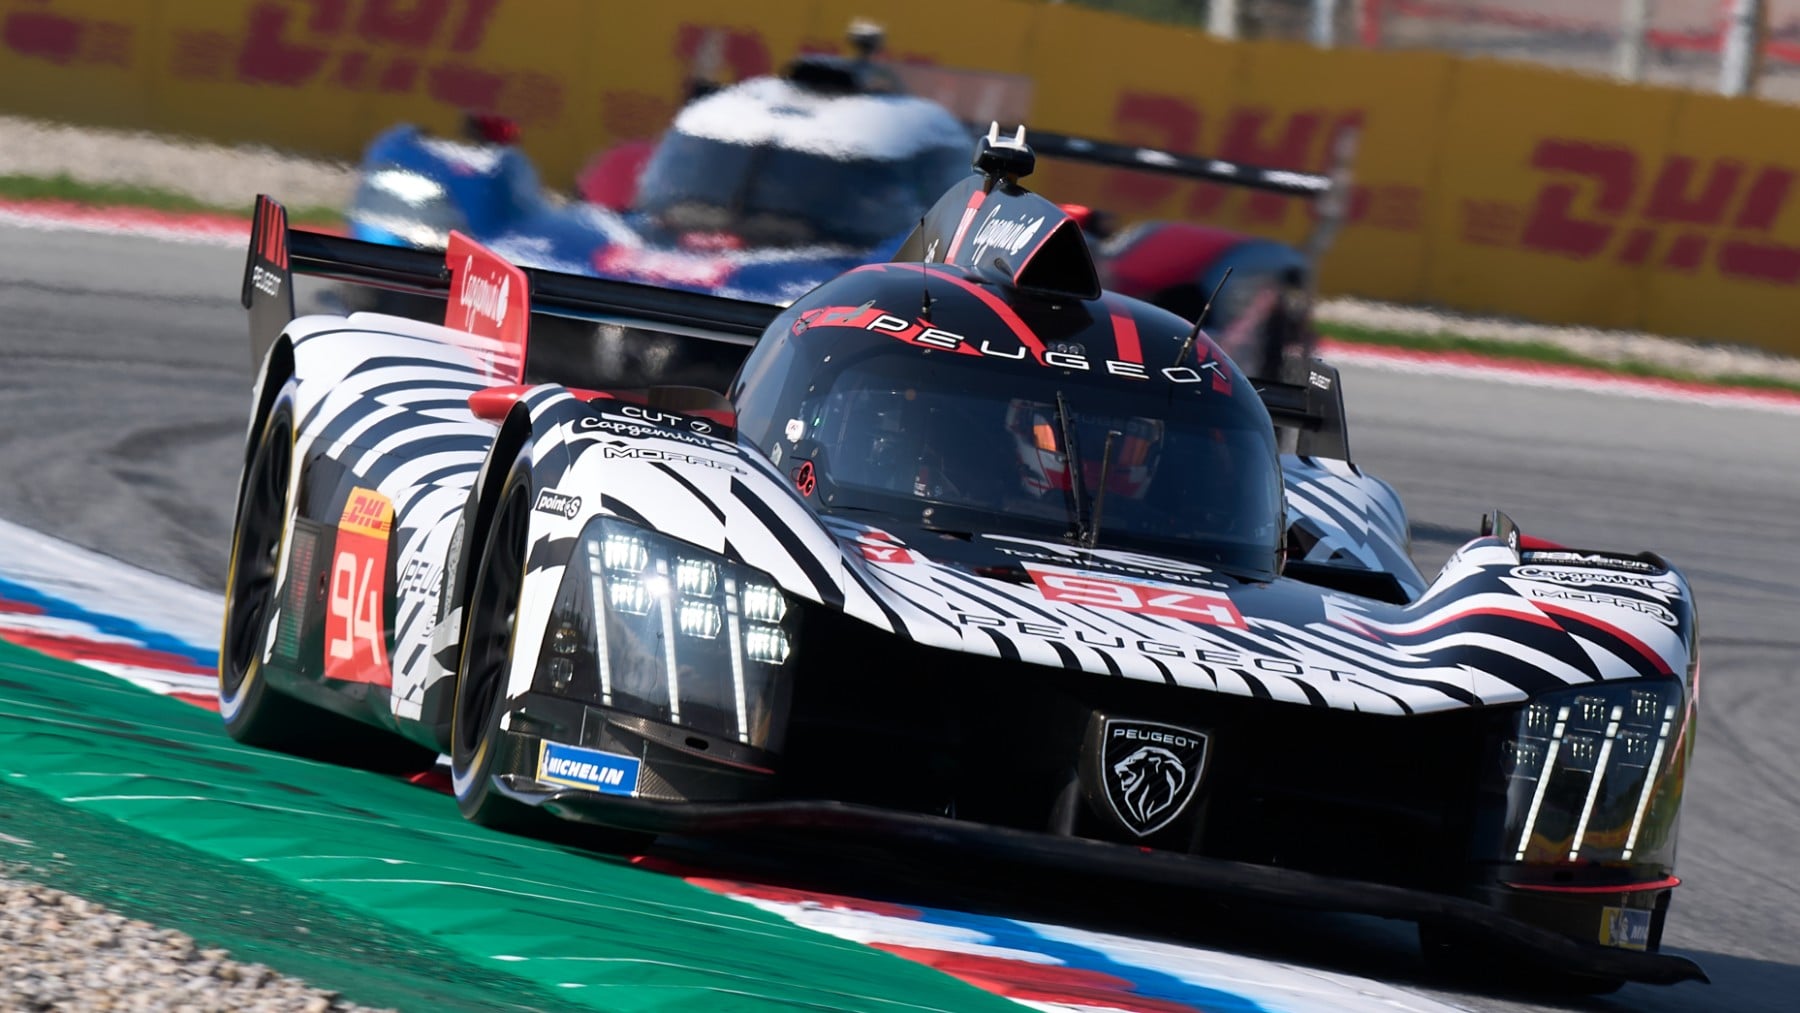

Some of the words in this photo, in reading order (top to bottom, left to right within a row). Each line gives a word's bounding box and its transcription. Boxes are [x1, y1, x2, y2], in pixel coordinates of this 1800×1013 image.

[971, 204, 1034, 266] Capgemini
[252, 265, 282, 298] PEUGEOT
[460, 254, 502, 334] Capgemini
[866, 314, 1228, 383] PEUGEOT
[580, 417, 711, 447] Capgemini
[621, 406, 683, 427] CUT
[348, 495, 386, 529] DHL
[994, 547, 1230, 588] TotalEnergies
[1518, 567, 1650, 589] Capgemini
[330, 551, 382, 665] 94
[1042, 575, 1236, 625] 94
[957, 612, 1356, 682] PEUGEOT
[1113, 728, 1199, 749] PEUGEOT
[548, 757, 625, 786] MICHELIN
